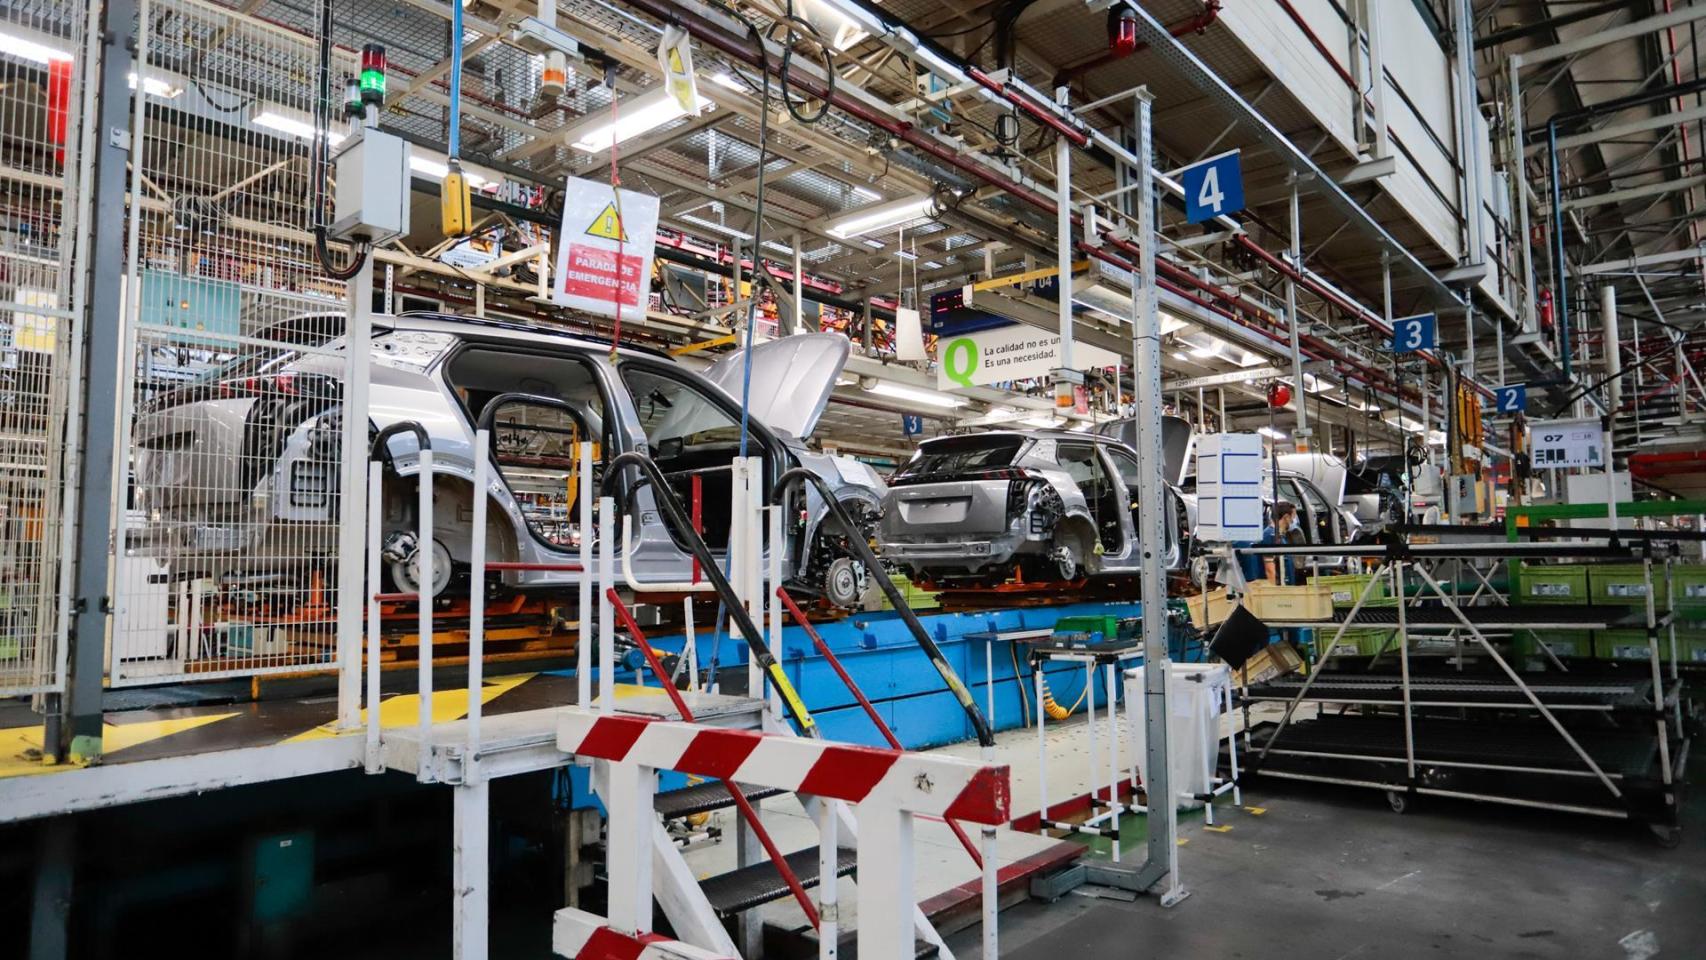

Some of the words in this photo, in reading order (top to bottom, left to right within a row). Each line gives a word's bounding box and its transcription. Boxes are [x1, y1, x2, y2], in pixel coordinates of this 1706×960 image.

[1198, 166, 1224, 212] 4
[576, 257, 616, 271] PARADA
[621, 264, 634, 276] DE
[568, 271, 637, 291] EMERGENCIA
[1406, 320, 1422, 348] 3
[984, 347, 994, 356] La
[996, 341, 1024, 354] calidad
[1039, 338, 1048, 346] es
[944, 337, 978, 388] Q
[984, 360, 994, 368] Es
[996, 358, 1011, 366] una
[1014, 350, 1056, 363] necesidad.
[1505, 389, 1518, 410] 2
[910, 416, 916, 432] 3
[1544, 434, 1564, 442] 07
